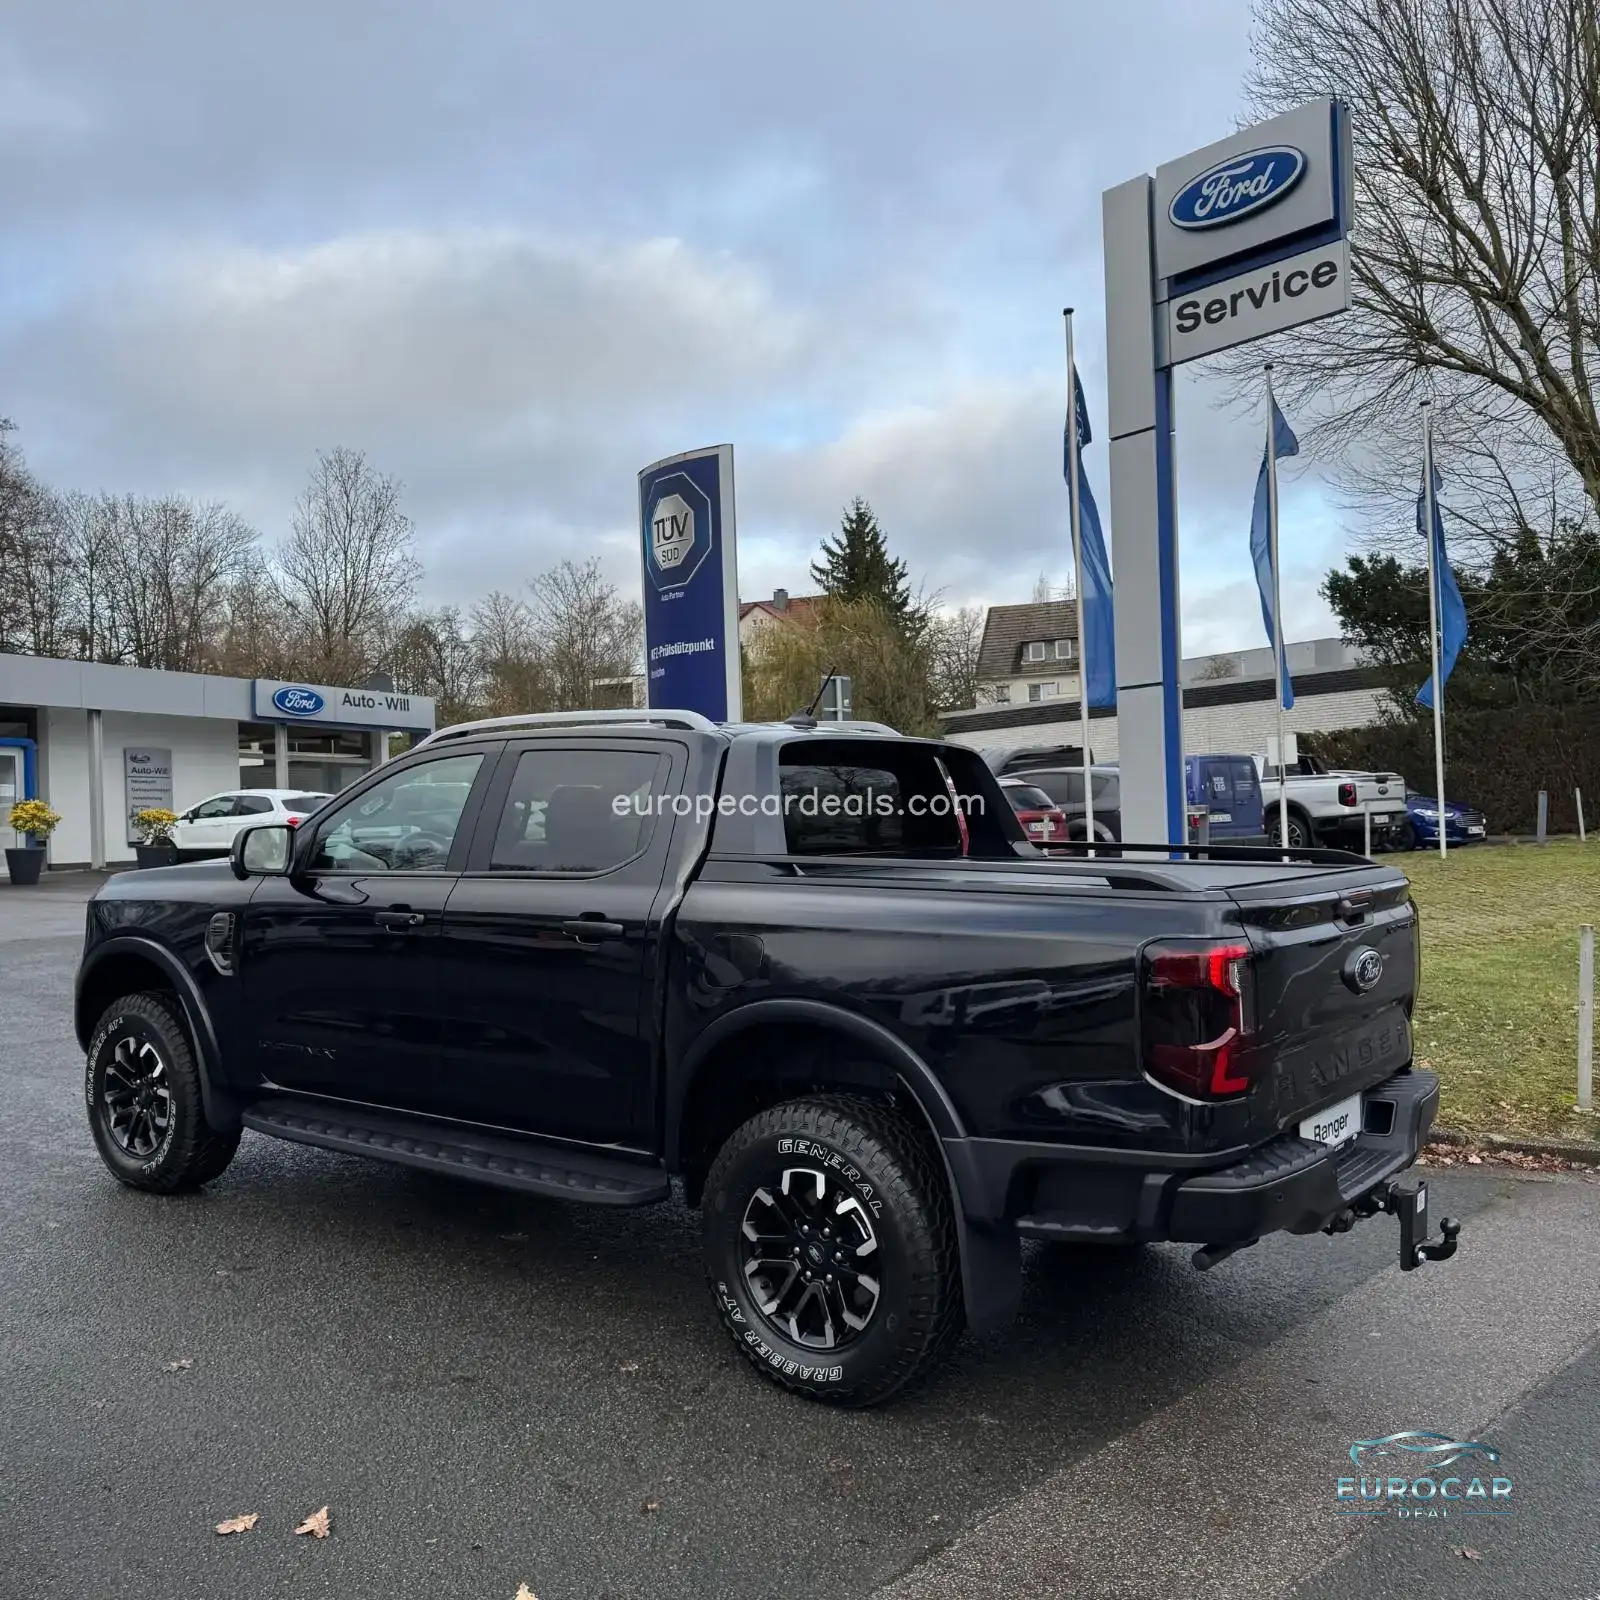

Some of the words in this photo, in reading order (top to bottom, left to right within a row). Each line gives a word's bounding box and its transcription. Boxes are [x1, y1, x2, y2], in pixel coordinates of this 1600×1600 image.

[1194, 161, 1275, 217] Ford
[1175, 260, 1338, 333] Service
[654, 512, 689, 543] TÜV
[285, 690, 316, 710] Ford
[342, 693, 375, 708] Auto
[385, 697, 410, 712] Will
[1314, 1113, 1349, 1141] Ranger
[778, 1138, 883, 1218] GENERAL
[744, 1330, 842, 1381] GRABBER
